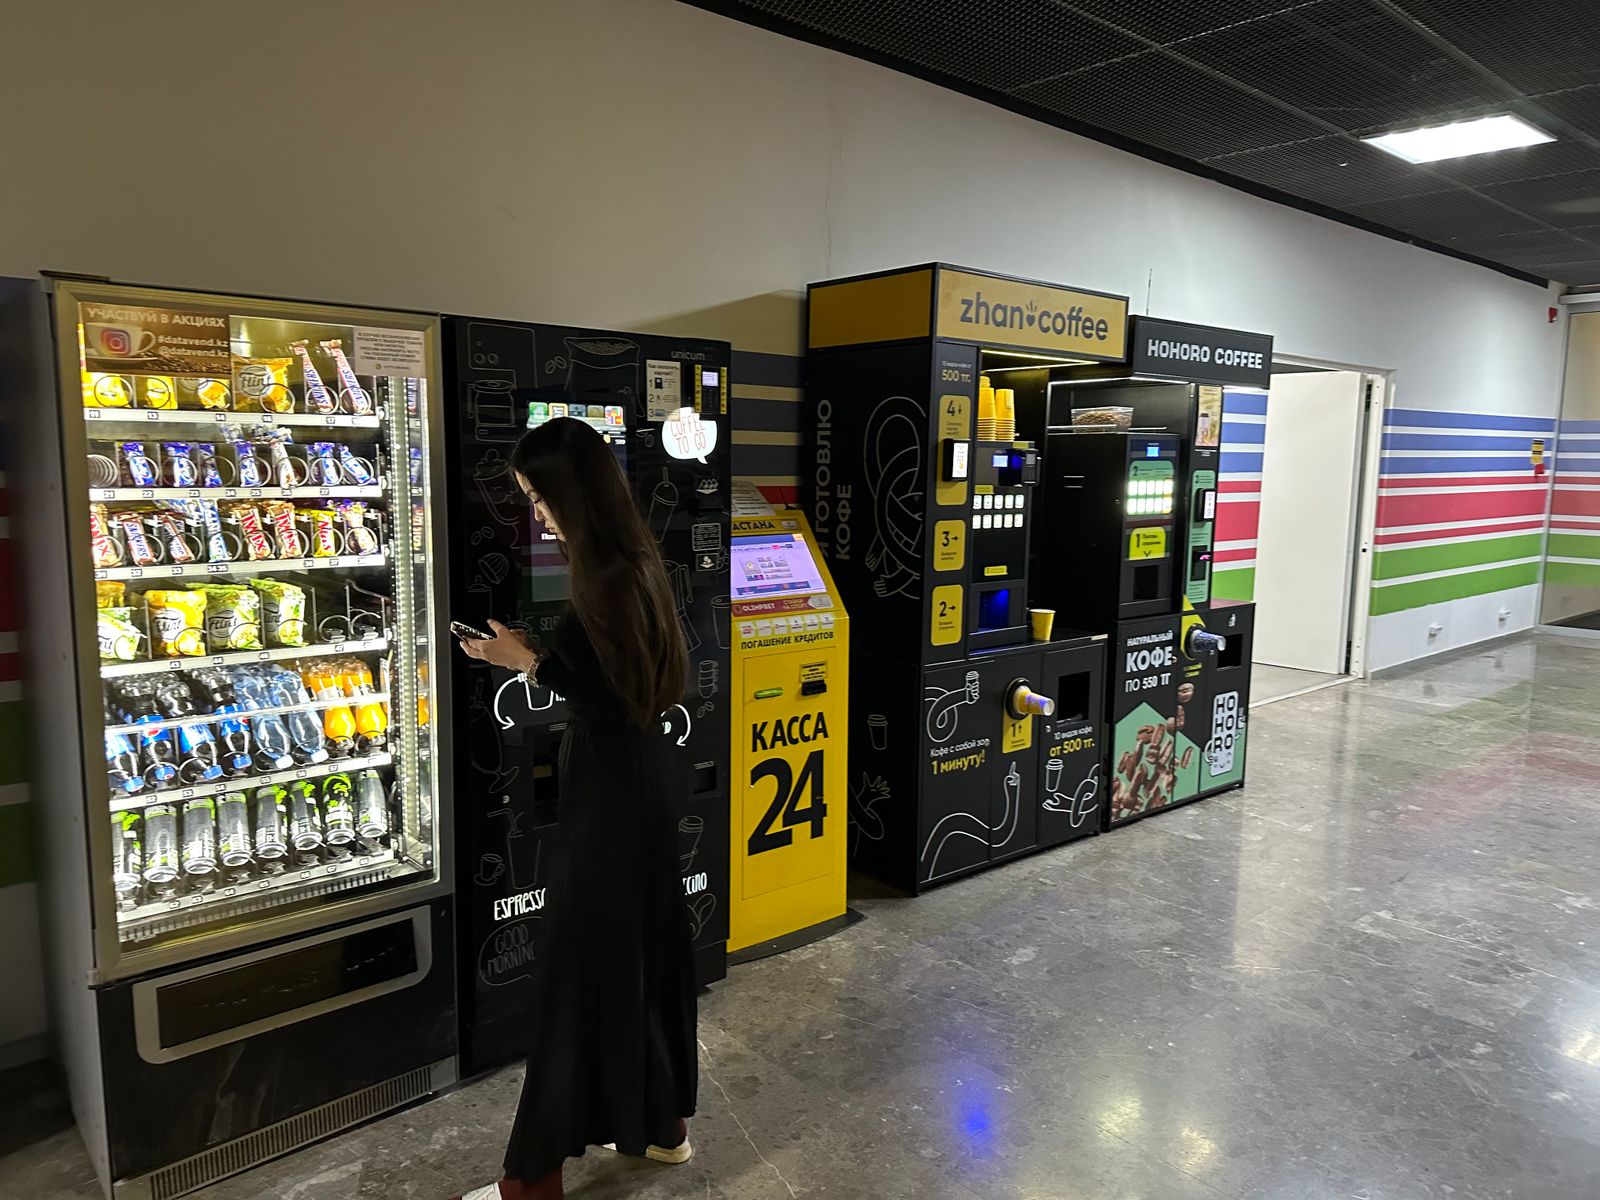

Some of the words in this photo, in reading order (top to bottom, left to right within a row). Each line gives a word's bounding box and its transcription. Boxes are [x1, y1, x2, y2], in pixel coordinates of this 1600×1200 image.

[86, 307, 157, 324] УЧАСТВУЙ
[160, 314, 169, 324] В
[172, 314, 226, 329] АКЦИЯХ
[960, 292, 1024, 331] zhan
[1037, 306, 1109, 341] coffee
[671, 350, 706, 361] unicum
[1147, 338, 1211, 364] HOHORO
[1213, 346, 1264, 370] COFFEE
[942, 369, 960, 382] 500
[648, 394, 654, 403] 2
[946, 400, 957, 417] 4
[648, 409, 655, 418] 3
[676, 436, 690, 455] TO
[694, 431, 707, 451] GO
[815, 399, 832, 534] ГОТОВЛЮ
[732, 520, 776, 532] АСТАНА
[835, 484, 852, 560] КОФЕ
[941, 531, 950, 547] 3
[1135, 533, 1141, 548] 1
[938, 601, 948, 618] 2
[741, 636, 793, 650] ПОГАШЕНИЕ
[794, 631, 834, 645] КРЕДИТОВ
[1127, 630, 1174, 647] НАТУРАЛЬНЫЙ
[1125, 646, 1173, 674] КОФЕ
[1125, 678, 1141, 693] ПО
[1142, 675, 1158, 690] 550
[1160, 673, 1172, 686] ТГ
[1215, 694, 1236, 715] HO
[752, 711, 829, 753] КАССА
[1010, 722, 1017, 738] 1
[1214, 713, 1236, 735] HO
[929, 745, 949, 758] Кофе
[955, 738, 976, 752] собой
[1049, 745, 1062, 757] от
[1063, 738, 1082, 754] 500
[1213, 733, 1234, 755] RO
[931, 760, 938, 775] 1
[940, 750, 986, 773] минуту!
[748, 749, 828, 857] 24
[495, 923, 529, 955] GOOD
